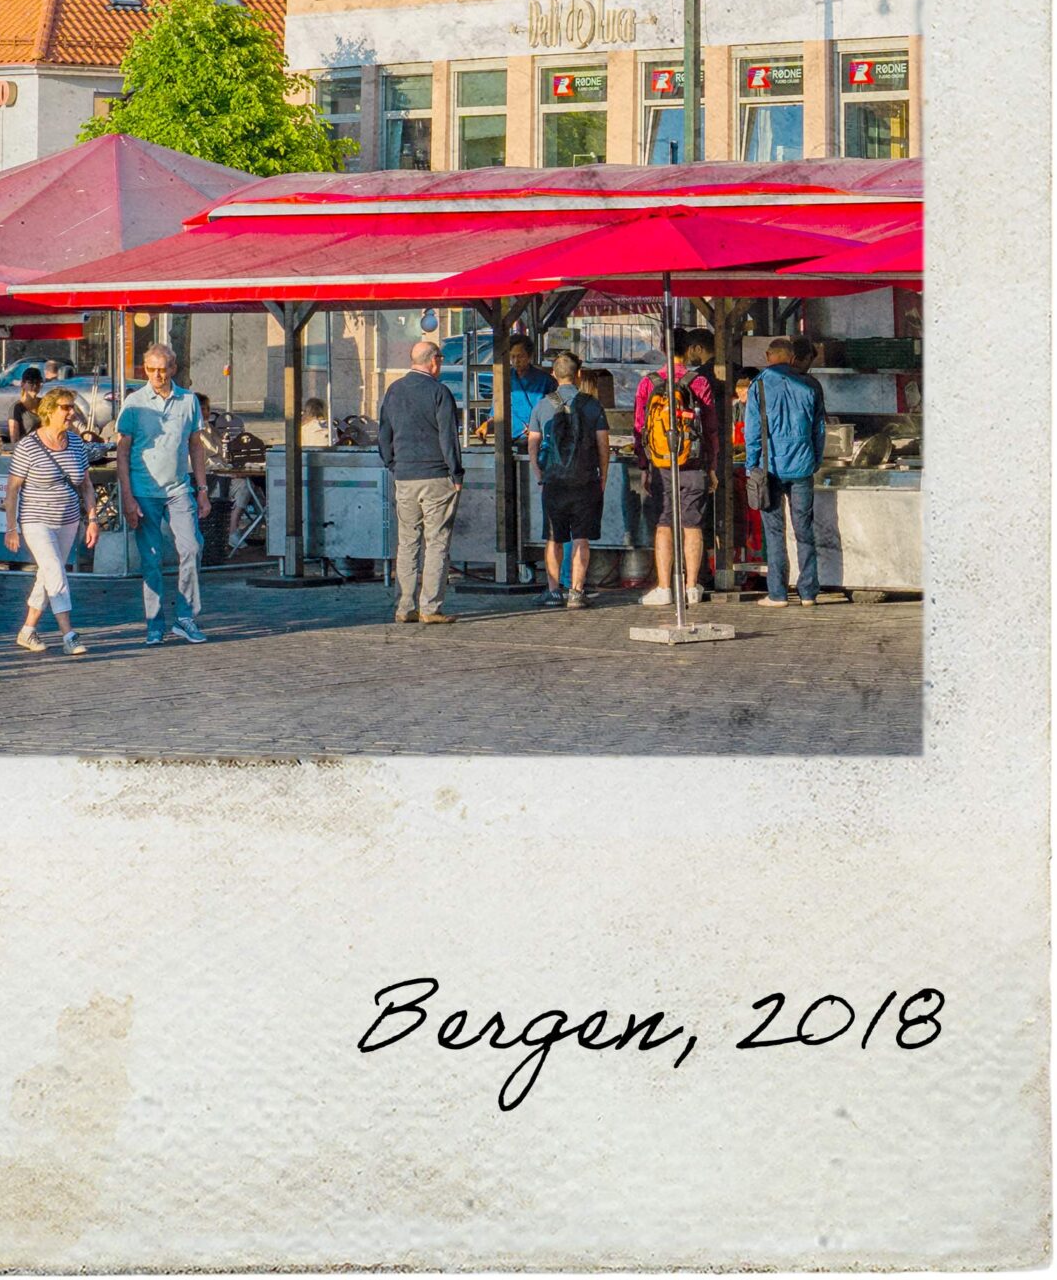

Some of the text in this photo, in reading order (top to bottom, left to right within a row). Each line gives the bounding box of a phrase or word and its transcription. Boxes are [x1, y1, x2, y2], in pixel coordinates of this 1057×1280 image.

[772, 68, 802, 79] RØDNE
[875, 62, 907, 74] RØDNE
[575, 76, 602, 87] RØDNE
